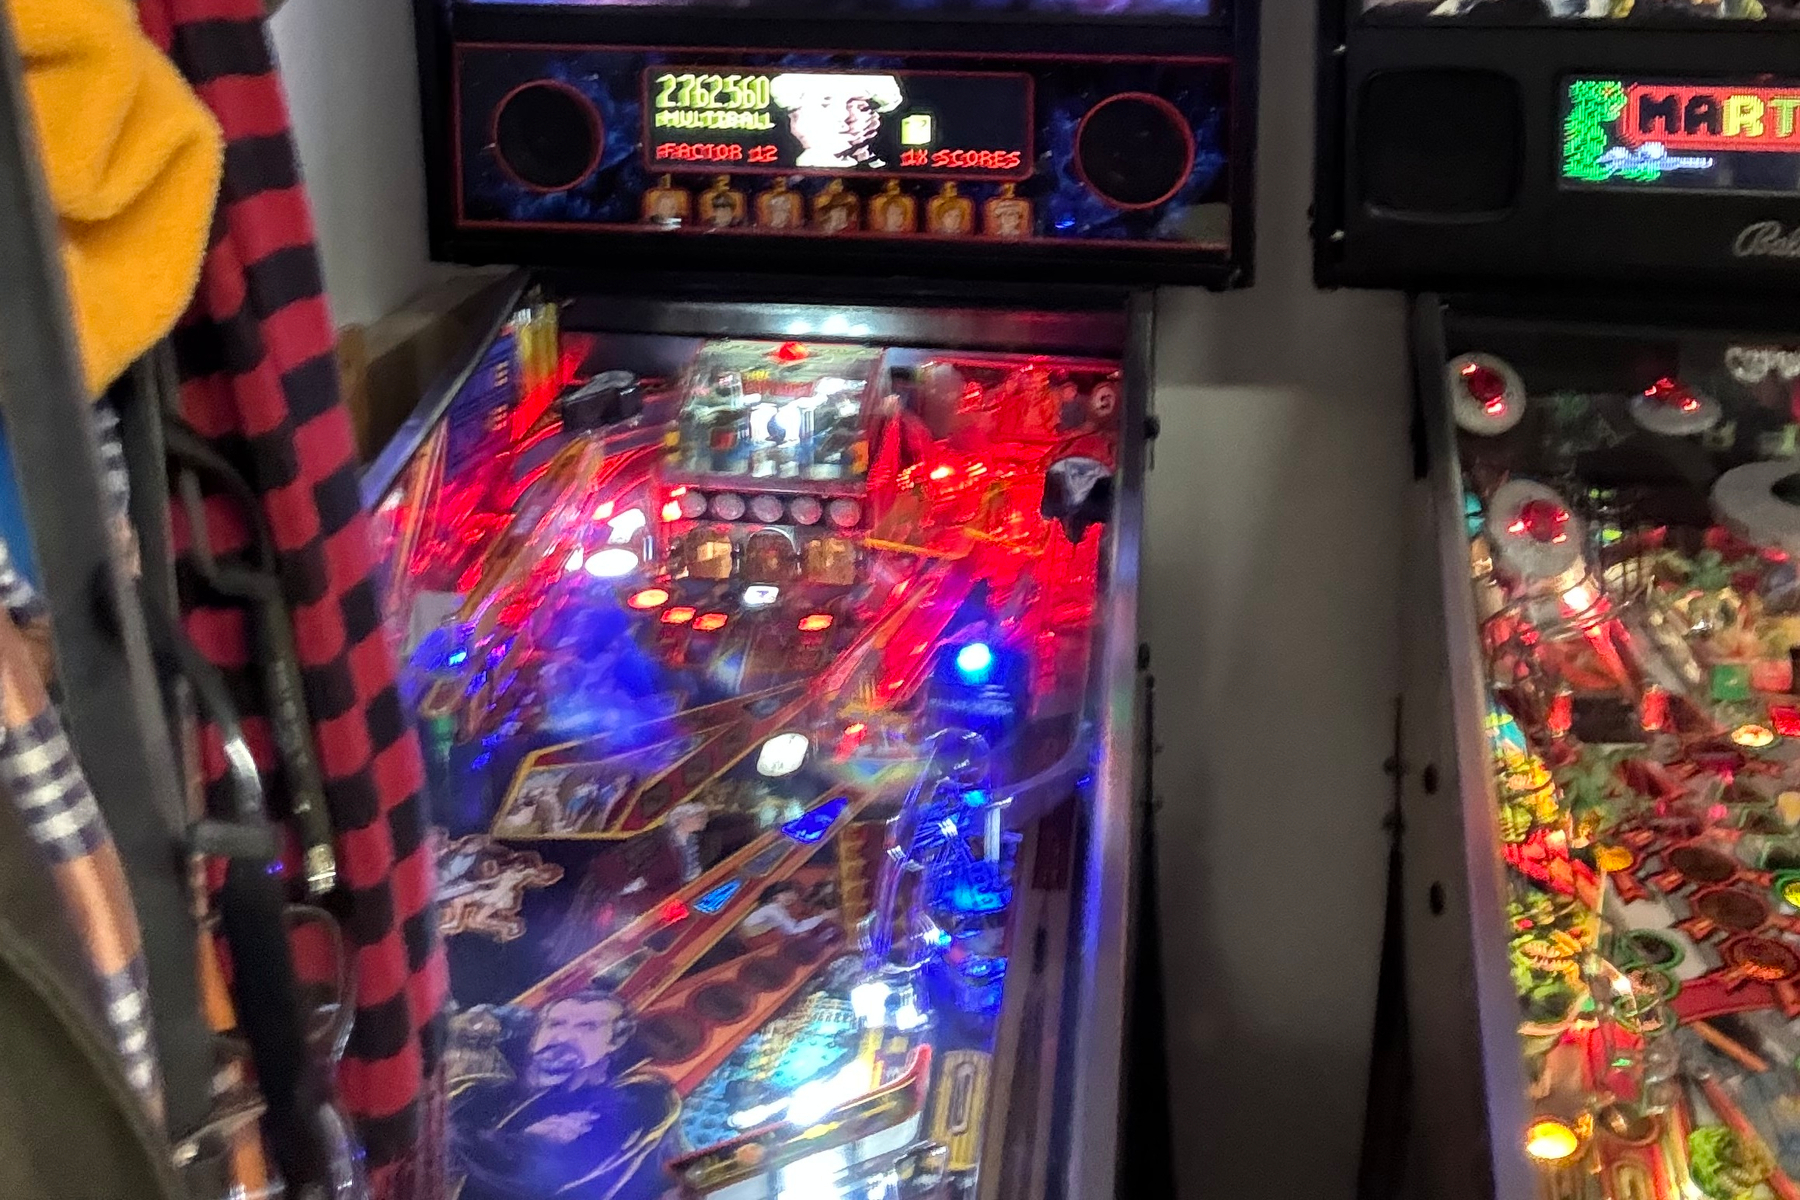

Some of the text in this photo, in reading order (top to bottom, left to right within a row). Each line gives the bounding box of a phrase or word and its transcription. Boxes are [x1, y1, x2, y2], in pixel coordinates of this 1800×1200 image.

[656, 74, 770, 109] 2762560
[656, 110, 776, 130] MULTIBALL
[656, 143, 778, 162] FACTOR 12
[931, 149, 1021, 169] SCORES
